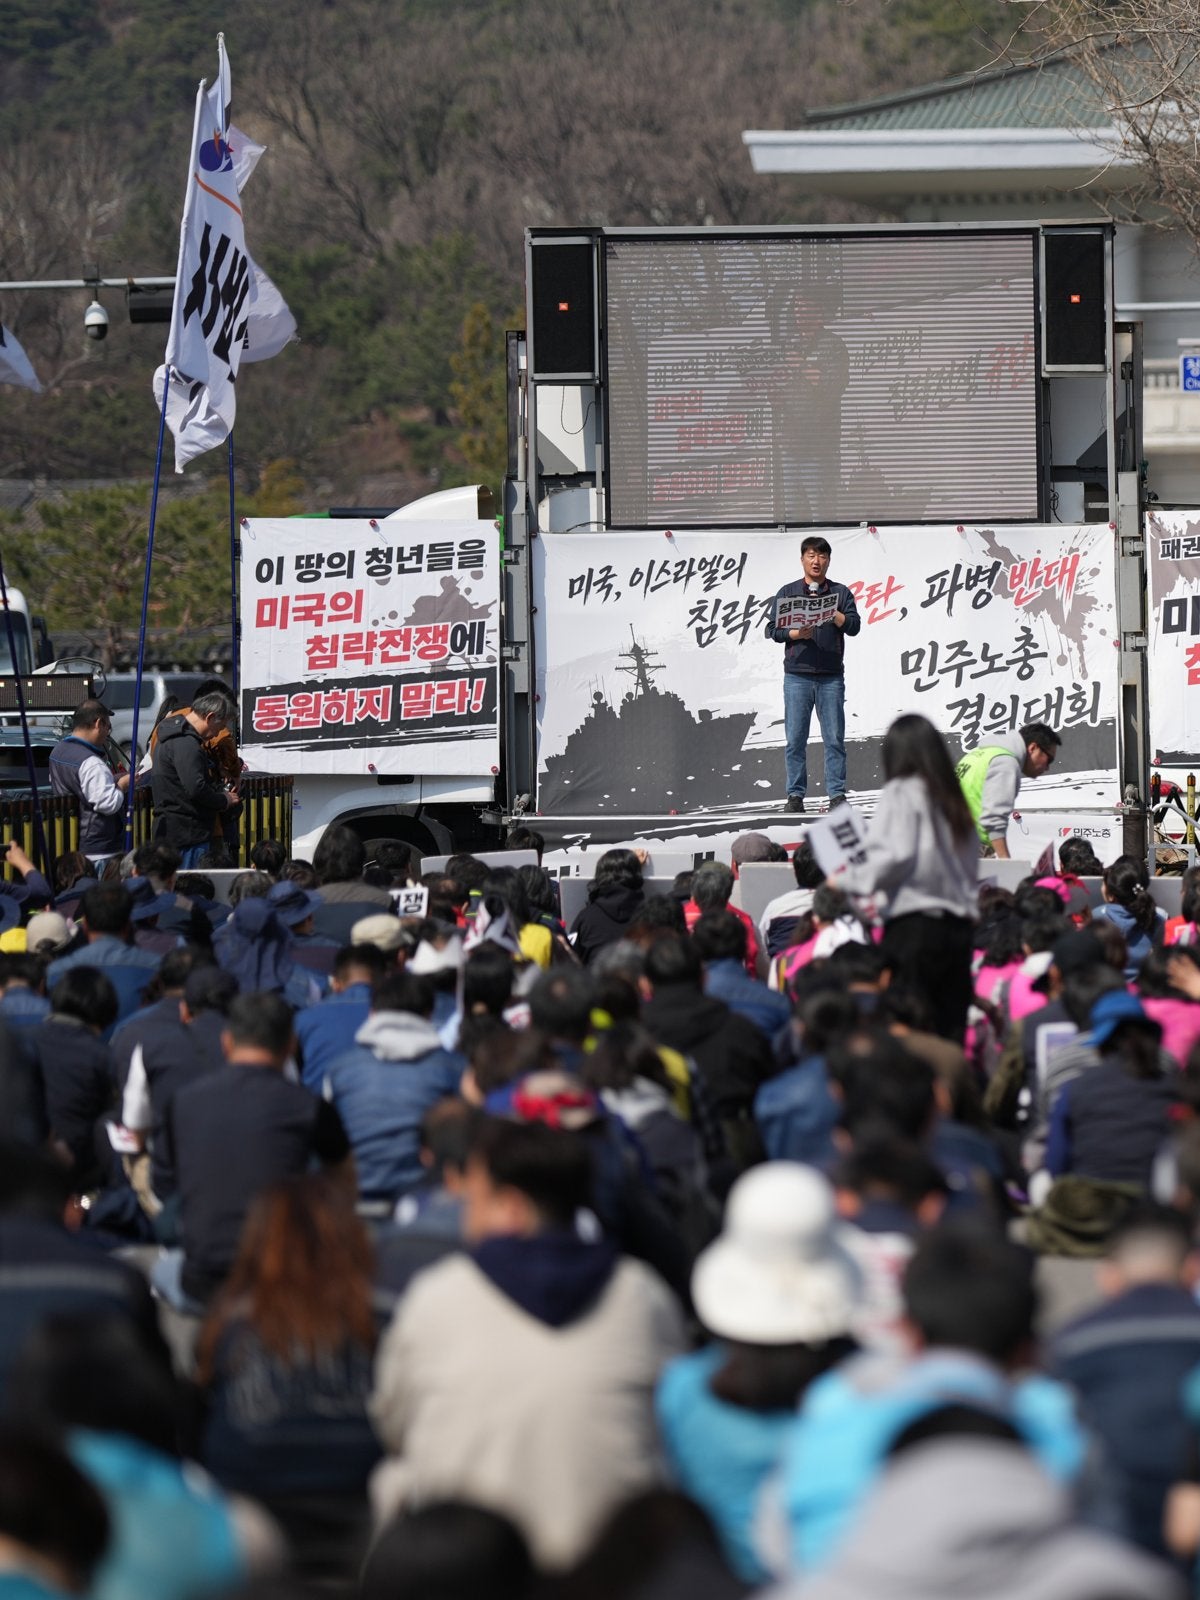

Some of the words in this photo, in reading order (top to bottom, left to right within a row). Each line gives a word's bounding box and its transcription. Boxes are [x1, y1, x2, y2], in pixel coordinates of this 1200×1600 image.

[255, 556, 285, 585] 이
[295, 550, 355, 584] 땅의
[364, 539, 486, 577] 청년들을
[568, 564, 622, 605] 미국,
[629, 552, 748, 595] 이스라엘의
[920, 560, 1002, 617] 파병
[1009, 553, 1080, 608] 반대
[255, 589, 364, 630] 미국의
[777, 608, 837, 630] 미국규탄
[779, 595, 838, 614] 침략전쟁
[305, 621, 486, 671] 침략전쟁에
[900, 625, 1048, 693] 민주노총
[252, 685, 393, 733] 동원하지
[400, 678, 487, 721] 말라!
[946, 680, 1101, 751] 결의대회
[1073, 828, 1111, 838] 민주노총
